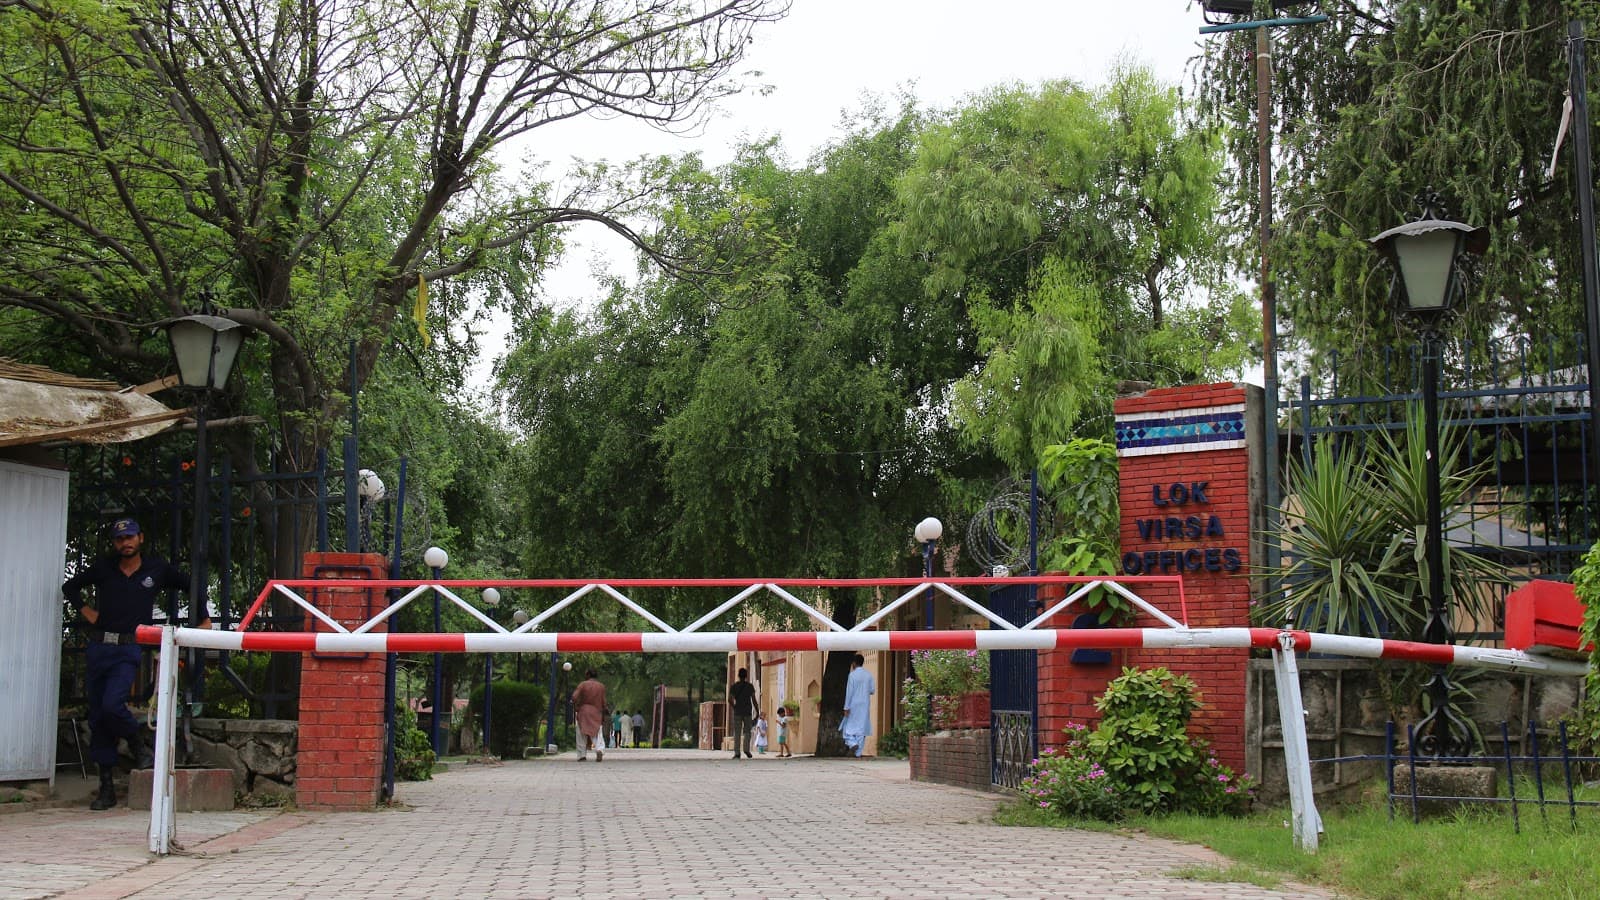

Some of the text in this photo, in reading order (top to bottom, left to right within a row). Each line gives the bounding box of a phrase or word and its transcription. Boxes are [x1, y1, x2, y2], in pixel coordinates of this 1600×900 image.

[1153, 481, 1209, 507] LOK
[1136, 515, 1224, 540] VIRSA
[1122, 547, 1241, 574] OFFICES
